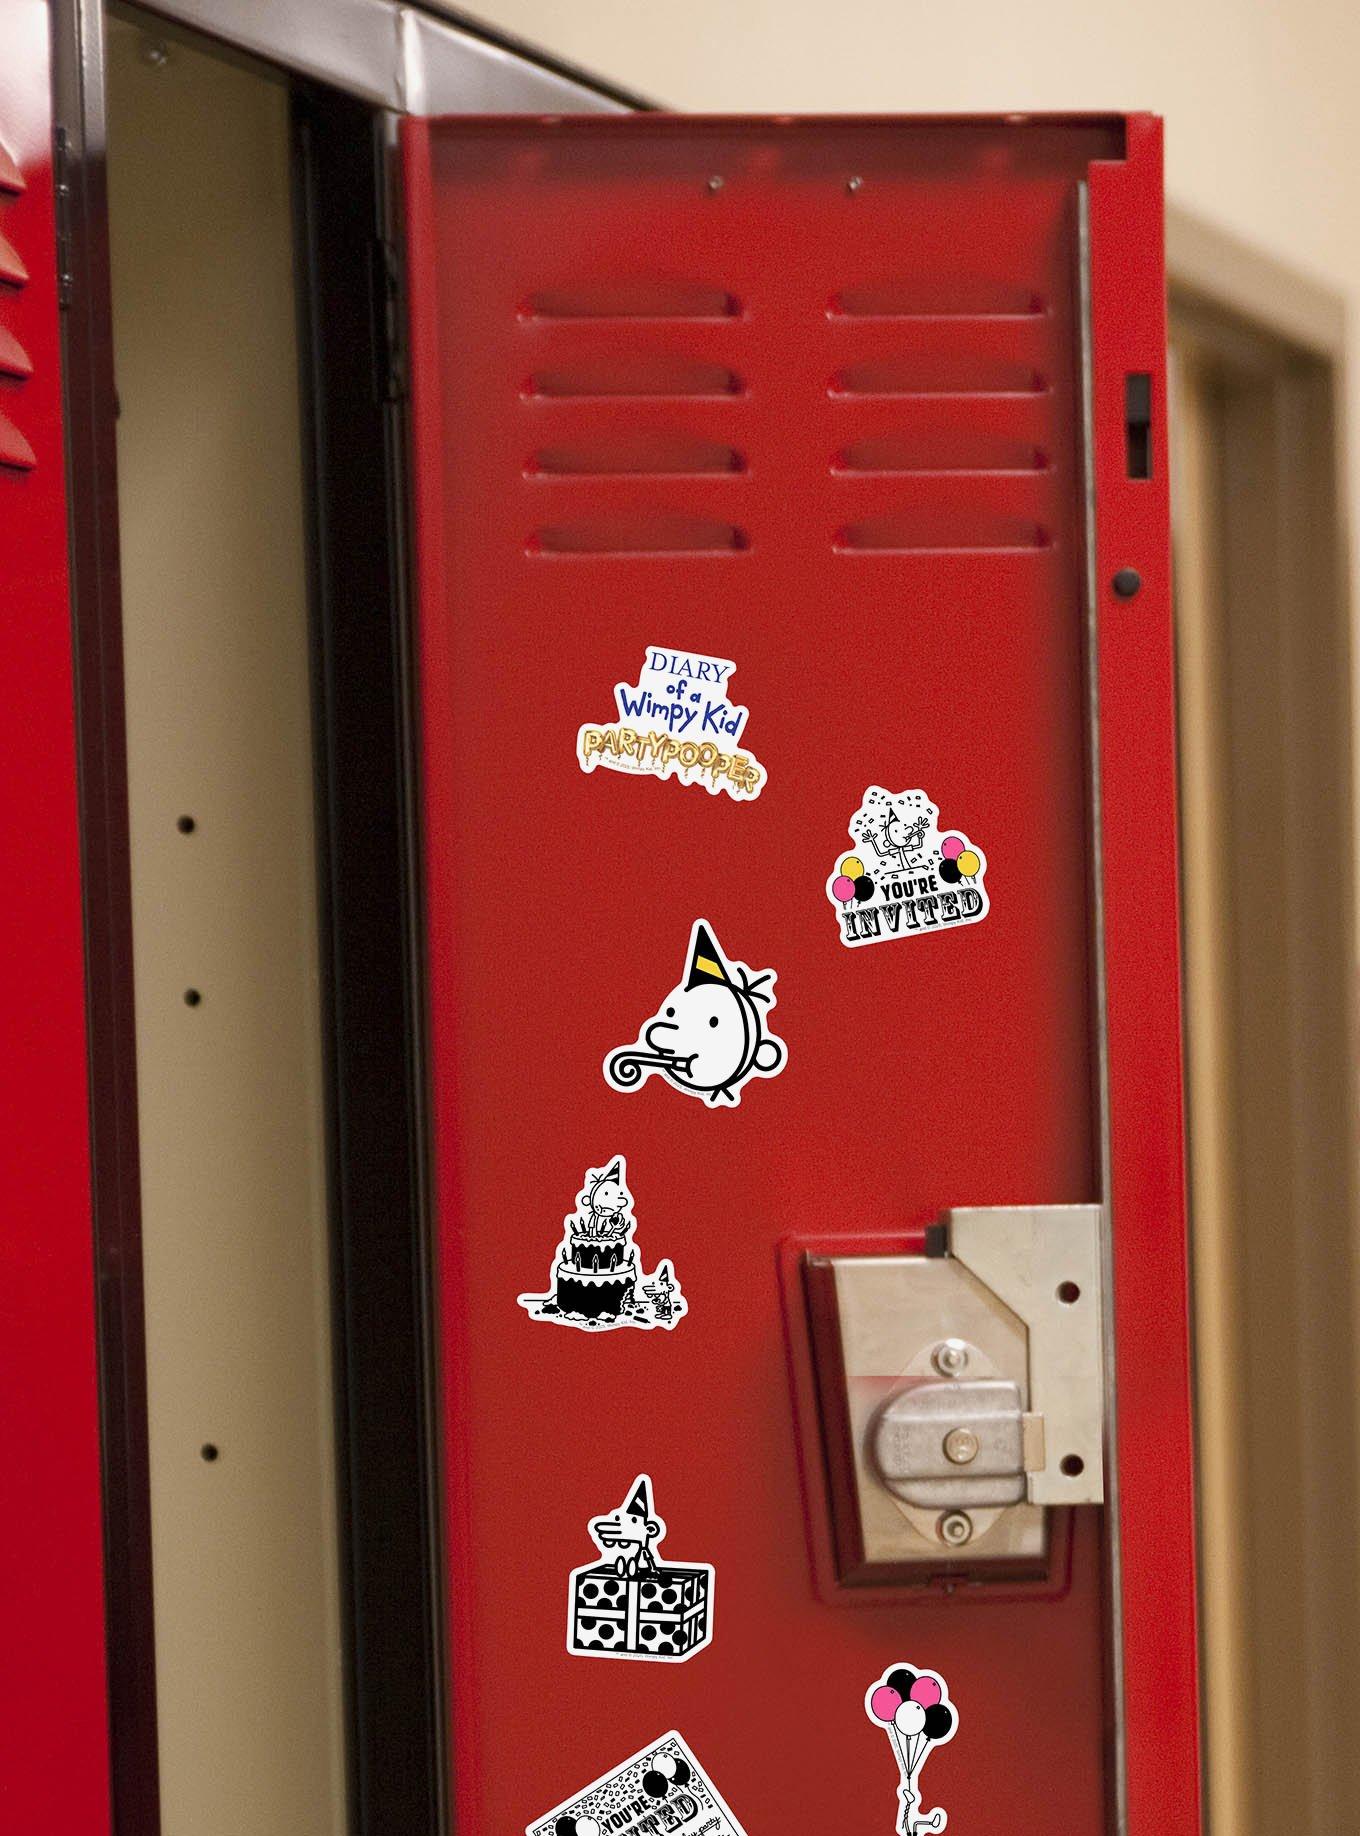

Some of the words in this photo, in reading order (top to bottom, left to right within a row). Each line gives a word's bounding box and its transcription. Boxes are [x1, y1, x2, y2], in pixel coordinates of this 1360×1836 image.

[649, 652, 730, 684] DIARY
[666, 680, 688, 700] of
[689, 692, 702, 703] a
[620, 688, 698, 733] Wimpy
[702, 700, 743, 736] Kid
[880, 874, 939, 902] YOU'RE
[842, 887, 984, 941] INVITED
[601, 1794, 652, 1834] YOU'RE
